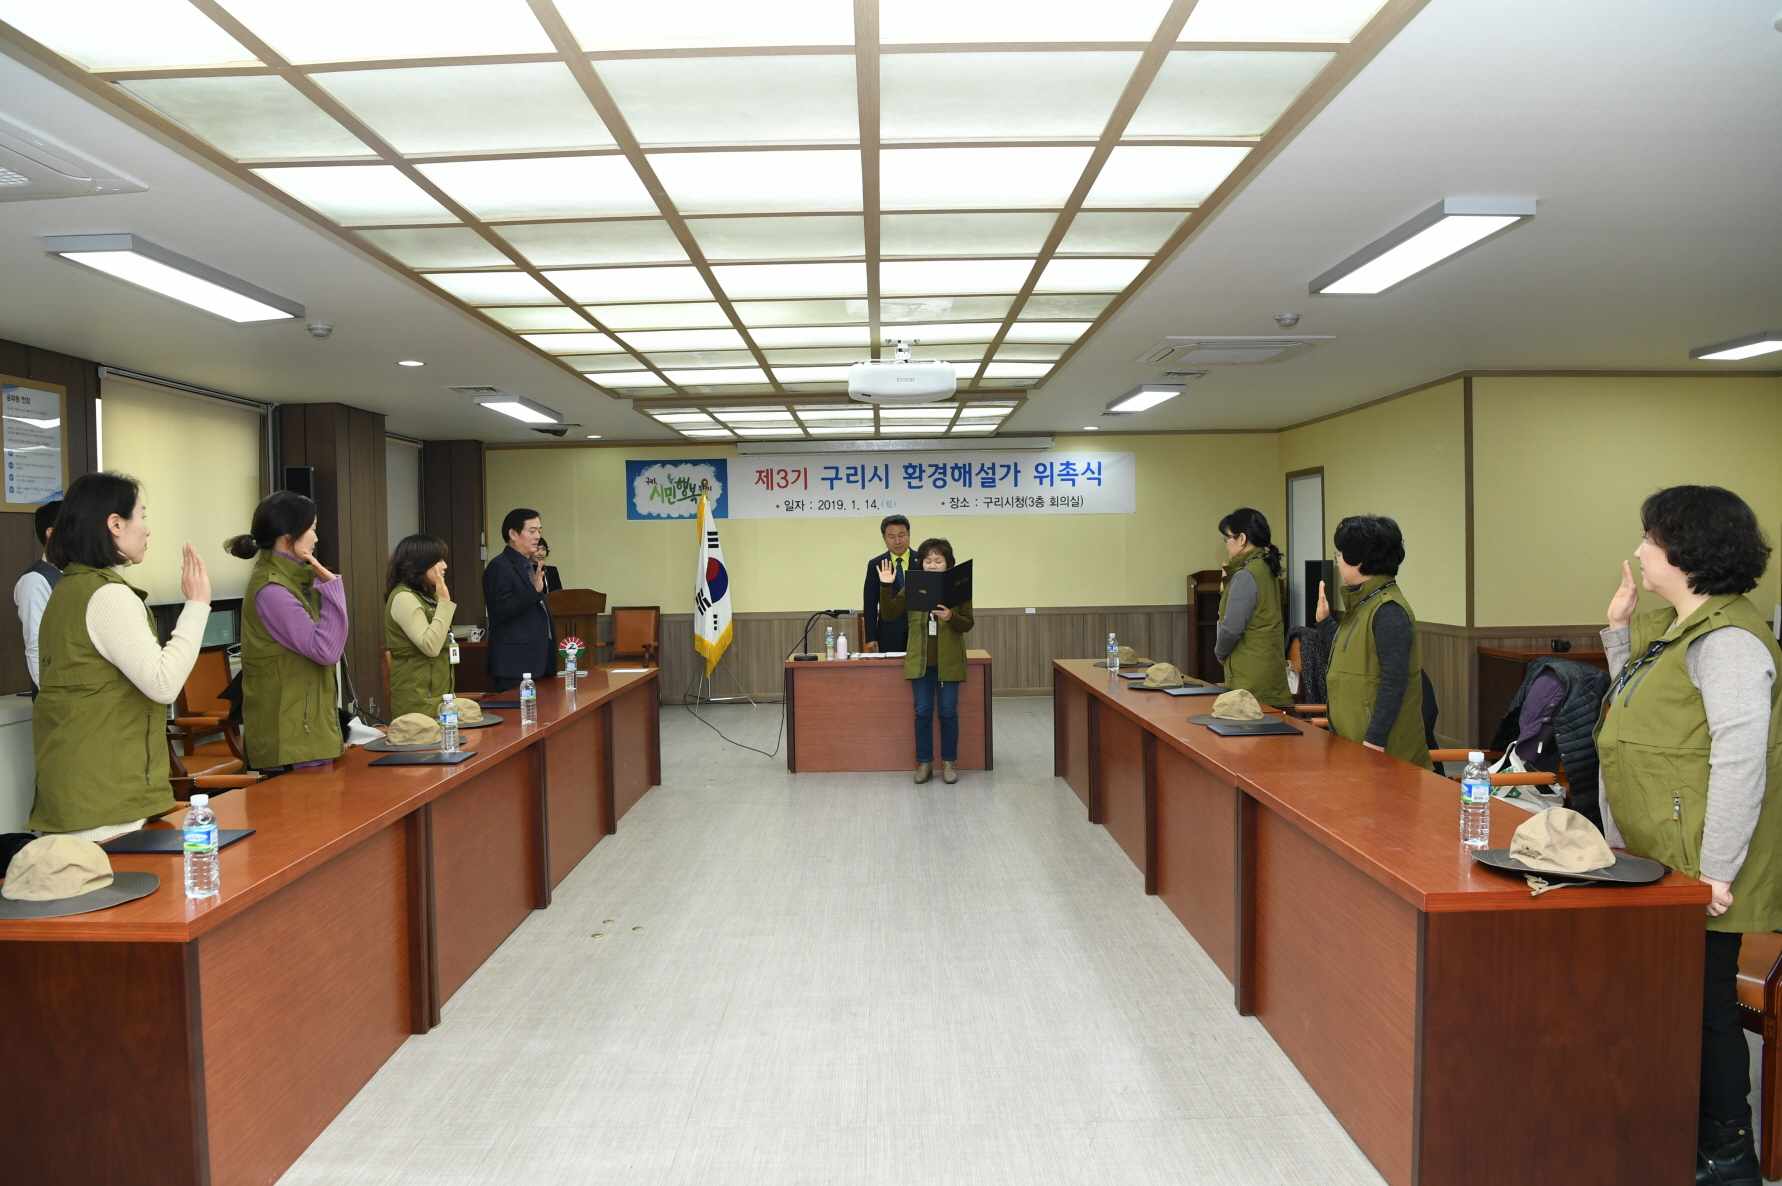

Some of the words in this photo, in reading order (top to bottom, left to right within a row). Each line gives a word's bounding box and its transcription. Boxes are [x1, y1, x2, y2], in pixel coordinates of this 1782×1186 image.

[755, 467, 808, 491] 제3기
[820, 463, 890, 490] 구리시
[902, 461, 1021, 489] 환경해설가
[1033, 460, 1103, 487] 위촉식
[784, 499, 805, 512] 일자
[818, 499, 847, 510] 2019.
[851, 499, 860, 510] 1.
[949, 496, 970, 509] 장소
[982, 496, 1045, 509] 구리시청(3층
[1049, 495, 1084, 508] 회의실)
